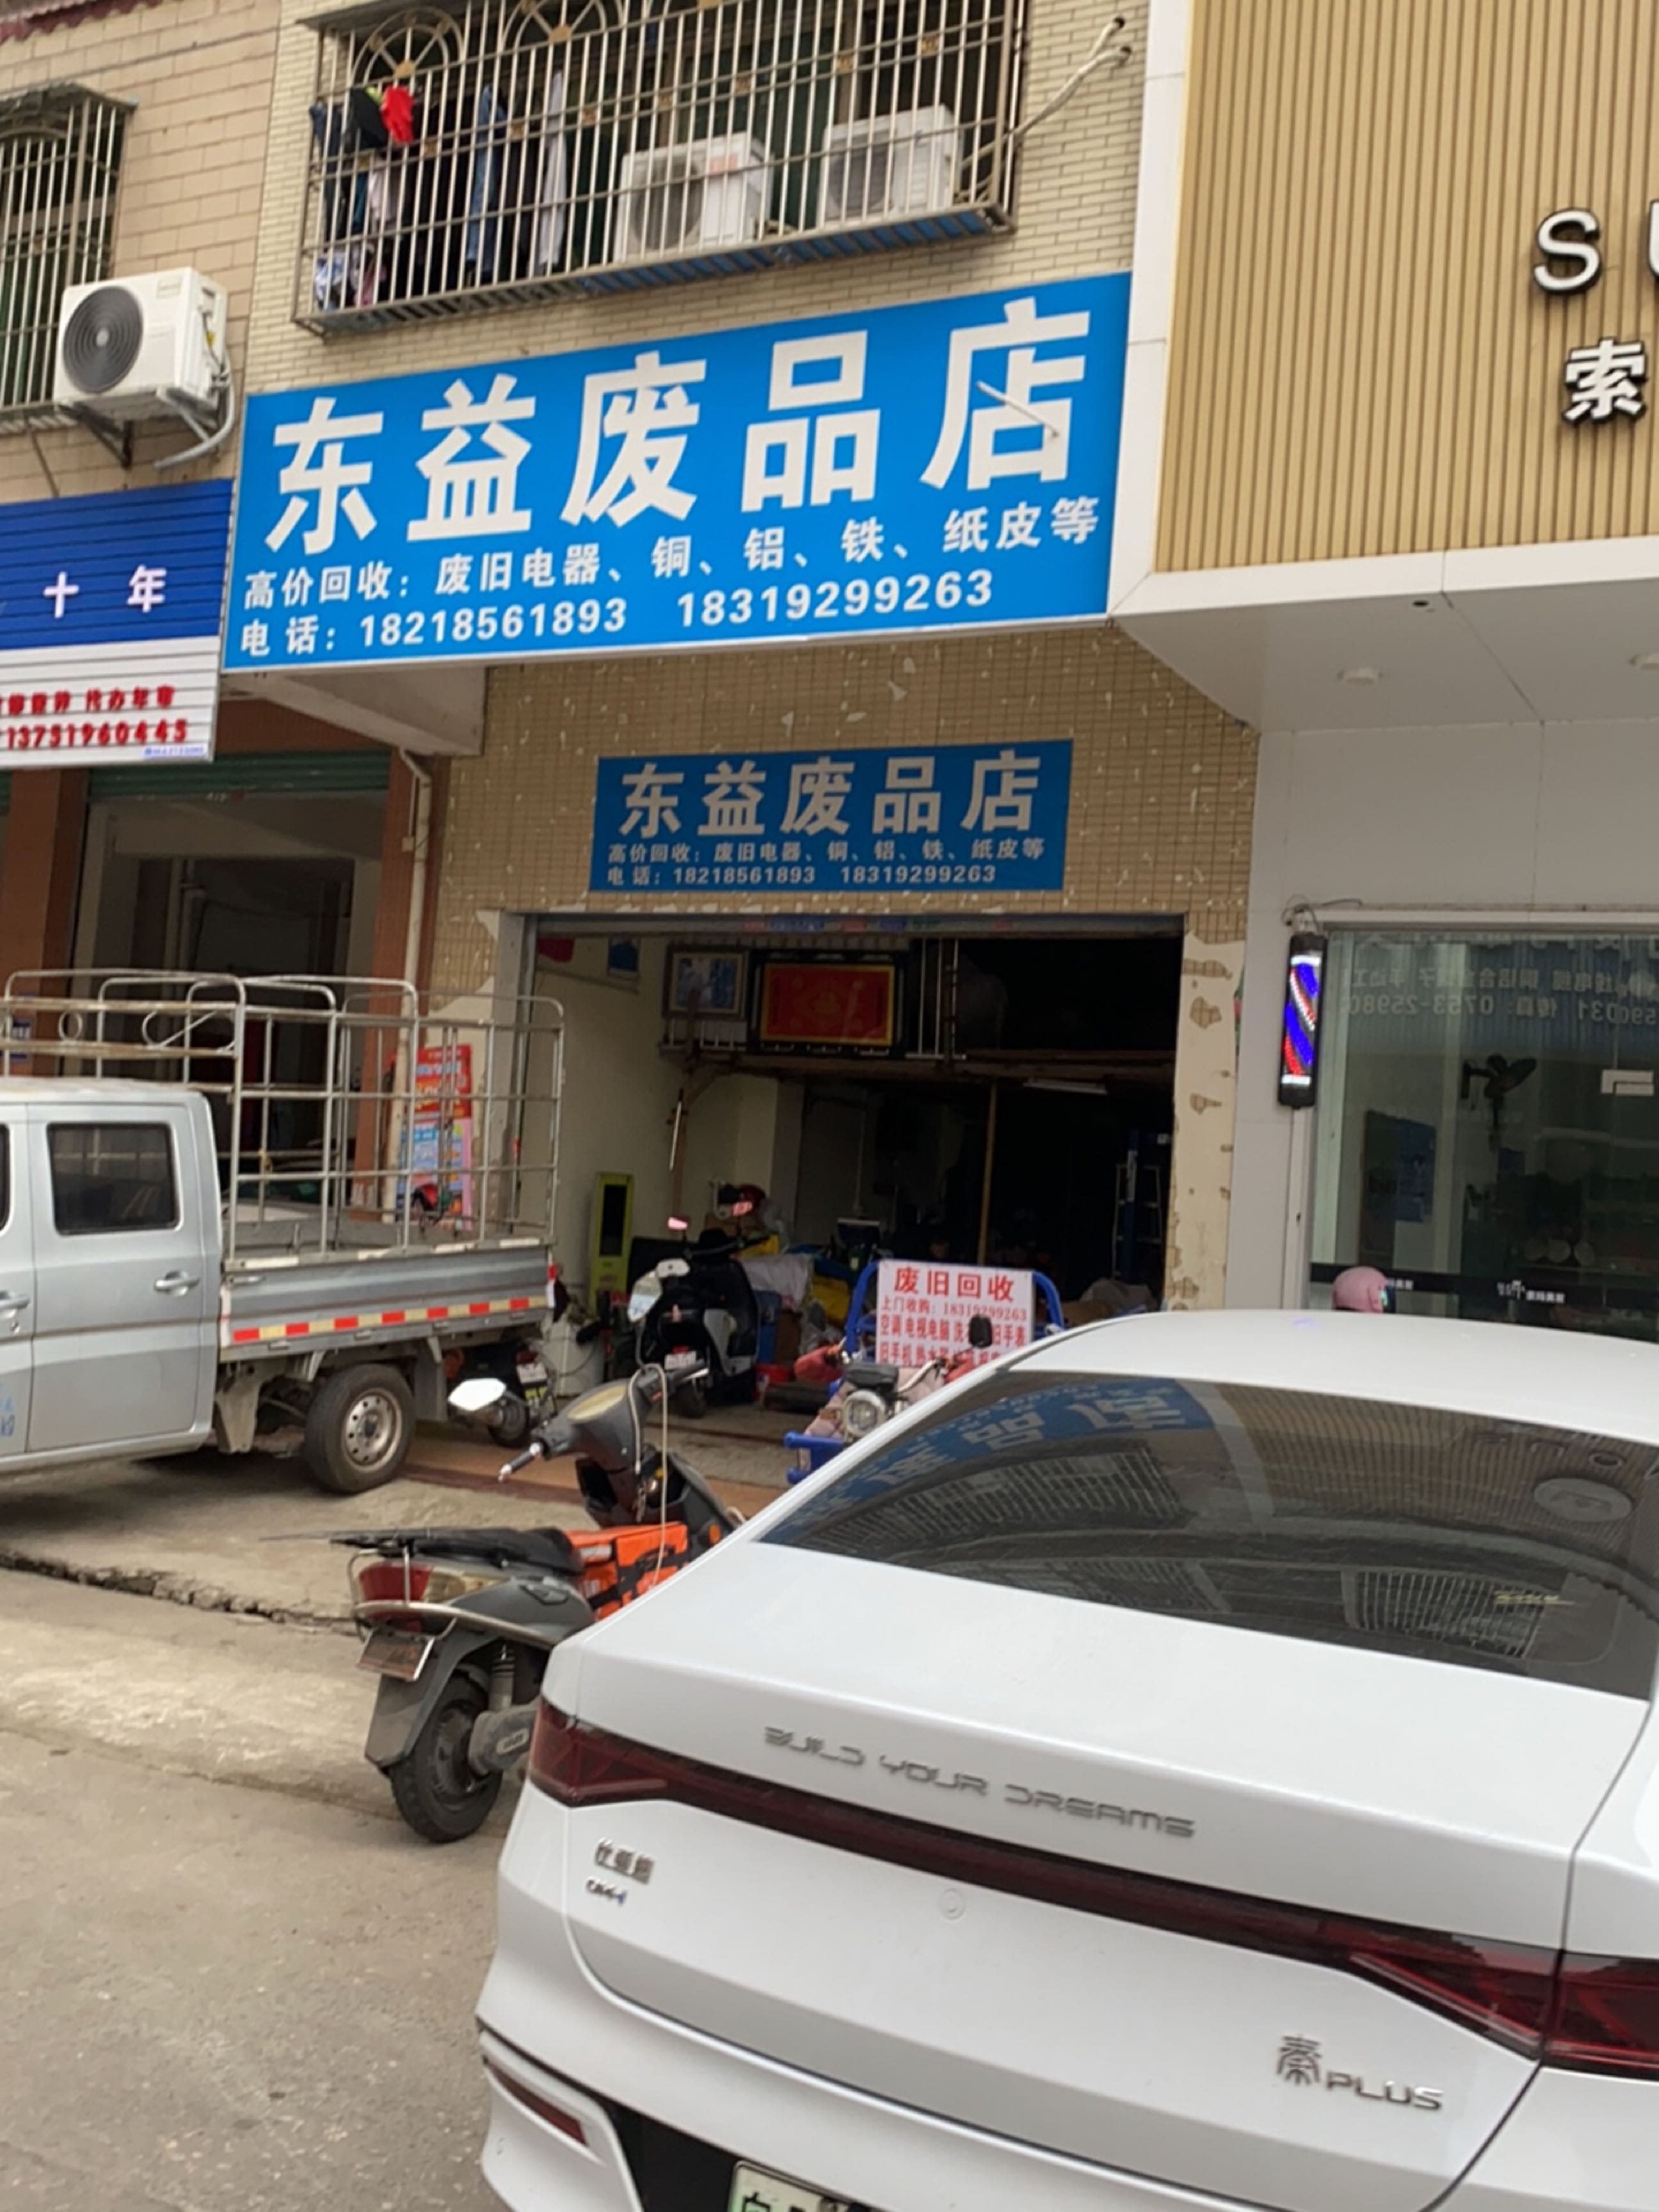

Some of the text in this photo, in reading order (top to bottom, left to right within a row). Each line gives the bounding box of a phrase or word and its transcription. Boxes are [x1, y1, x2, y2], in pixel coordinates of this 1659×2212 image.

[1564, 338, 1646, 421] 索
[265, 296, 1091, 556] 东益废品店
[677, 569, 993, 627] 18319299263
[619, 749, 1041, 837] 东益废品店
[841, 865, 996, 885] 18319299263
[894, 1267, 1014, 1302] 废旧回收
[764, 1726, 1196, 1839] BUILD YOUR DREAMS
[1326, 2069, 1445, 2111] PLUS
